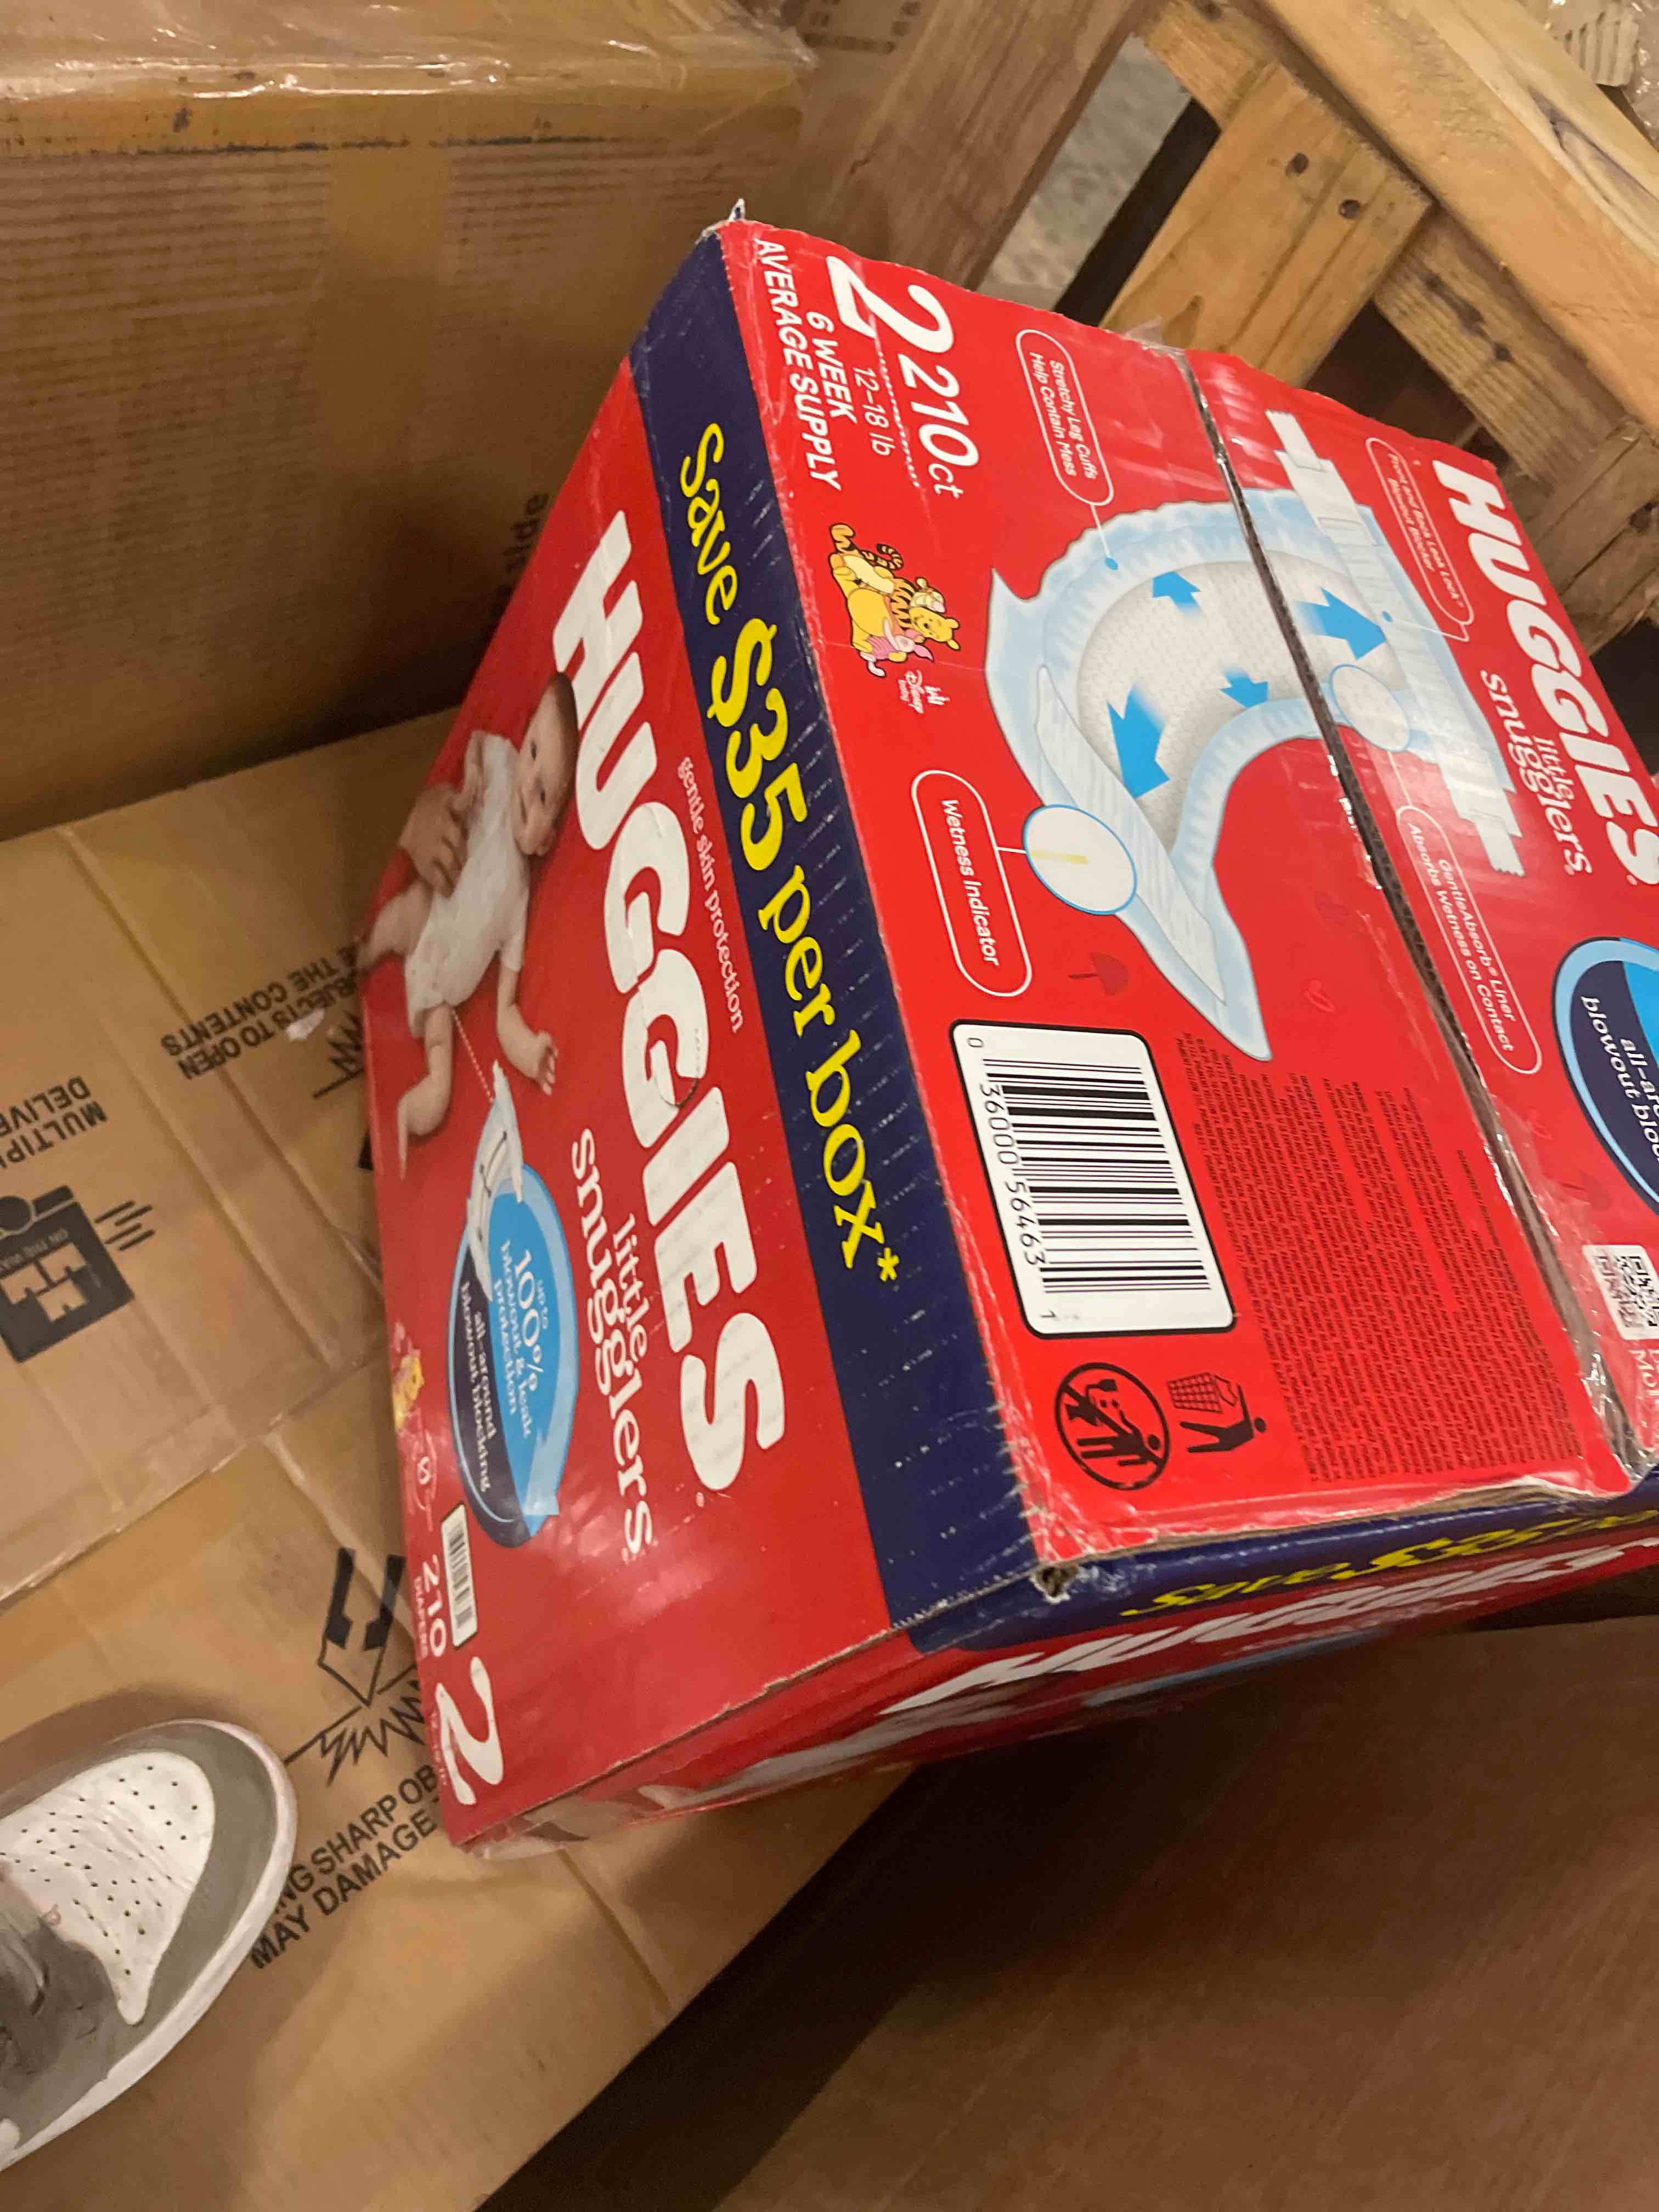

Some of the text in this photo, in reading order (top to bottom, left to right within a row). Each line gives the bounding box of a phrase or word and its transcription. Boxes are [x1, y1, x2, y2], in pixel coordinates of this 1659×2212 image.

[754, 239, 842, 490] AVERAGE SUPPLY
[808, 311, 857, 425] 6 WEEK
[827, 256, 953, 353] 2
[872, 436, 895, 456] lb
[1030, 352, 1077, 477] Help Contain Mess
[1049, 360, 1098, 479] Stretchy Leg Cuffs
[1432, 460, 1659, 885] HUGGIES
[708, 617, 808, 871] $35
[758, 864, 836, 1037] per
[1480, 670, 1592, 874] snugglers
[1535, 736, 1574, 800] little
[678, 757, 744, 1032] gentle skin protection
[941, 799, 999, 966] Wetness Indicator
[1408, 823, 1514, 1052] Absorbs Wetness on Contact
[161, 981, 287, 1056] CONTENTS
[178, 1036, 241, 1080] OPEN
[240, 1019, 274, 1047] TO
[552, 510, 785, 1492] HUGGIES
[1489, 978, 1517, 1022] Liner
[1581, 996, 1642, 1099] blowout
[967, 1037, 1058, 1321] 0 36000 56463 1
[514, 1249, 545, 1392] 100%
[571, 1127, 654, 1557] snugglers
[612, 1213, 650, 1363] little
[421, 1554, 447, 1657] 210
[435, 1656, 504, 1805] 2
[251, 1809, 437, 1969] MAY DAMAGE
[311, 1794, 397, 1875] SHARP
